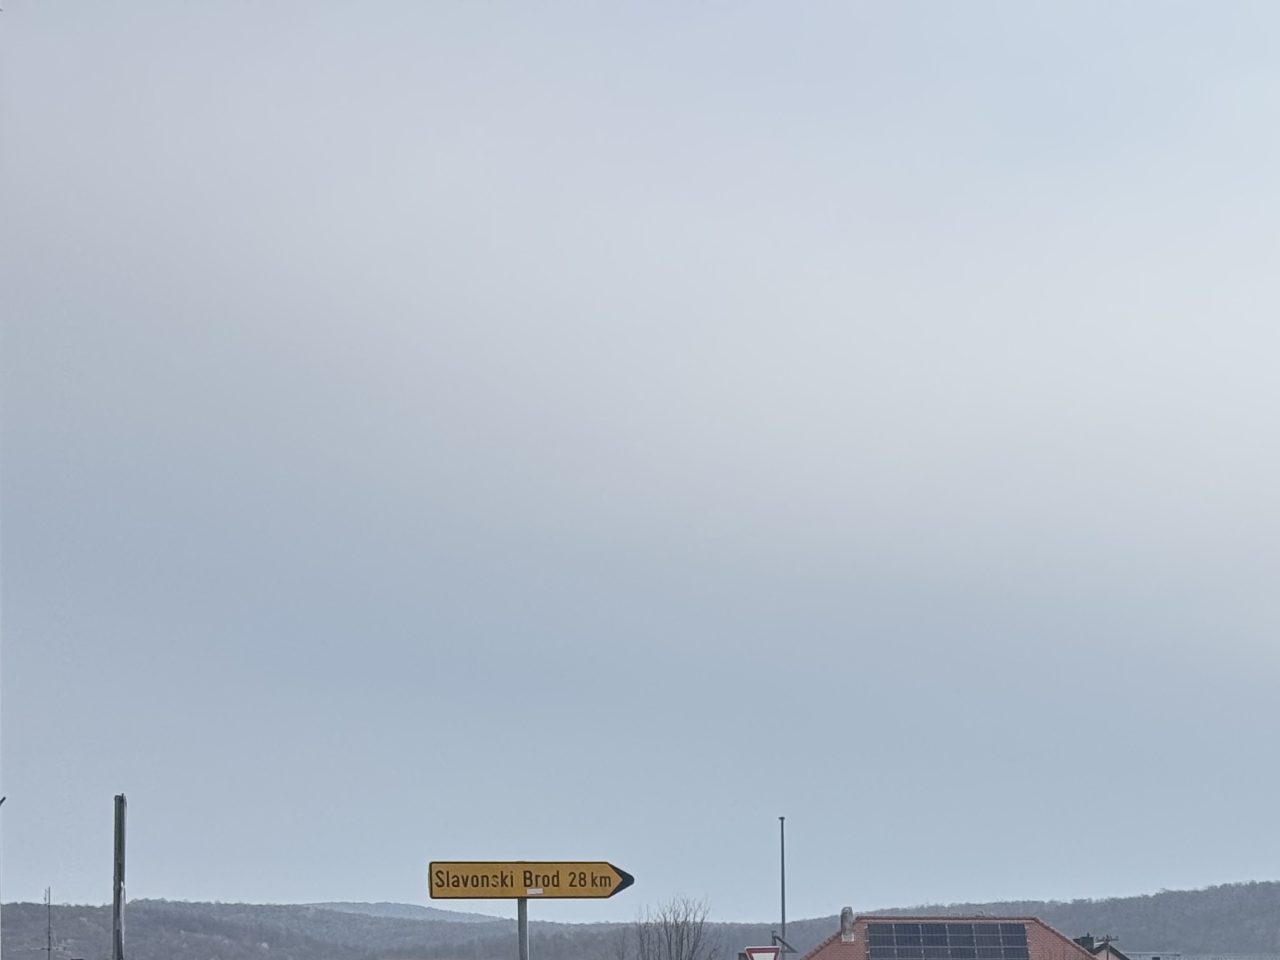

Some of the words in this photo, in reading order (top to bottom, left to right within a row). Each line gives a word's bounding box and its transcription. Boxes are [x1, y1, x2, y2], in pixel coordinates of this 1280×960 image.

[434, 870, 514, 888] Slavonski
[523, 870, 560, 888] Brod
[568, 871, 587, 888] 28
[591, 872, 612, 888] km
